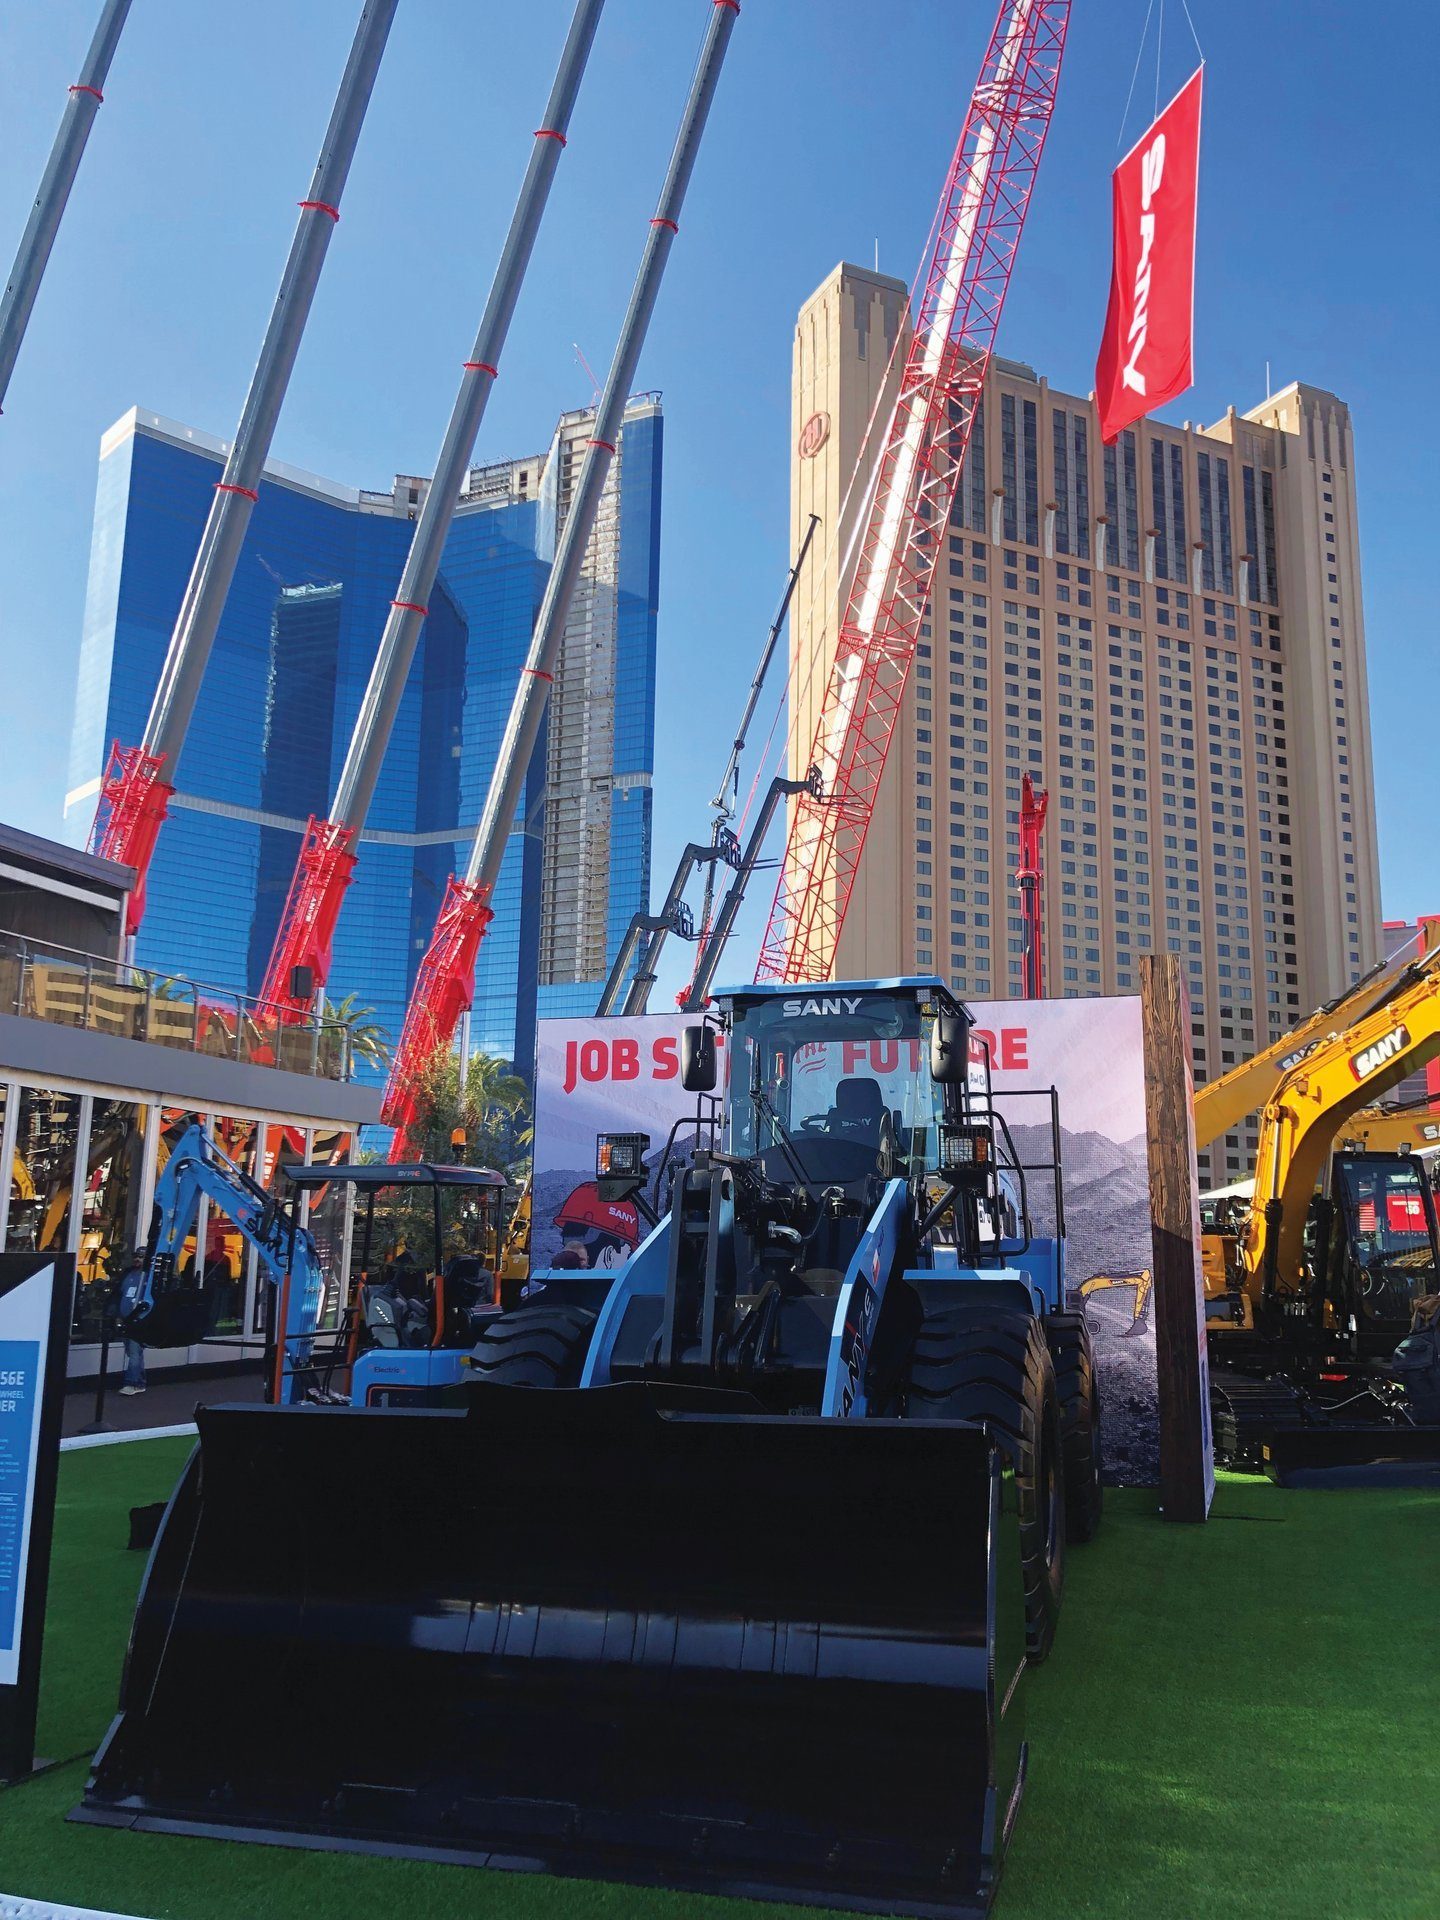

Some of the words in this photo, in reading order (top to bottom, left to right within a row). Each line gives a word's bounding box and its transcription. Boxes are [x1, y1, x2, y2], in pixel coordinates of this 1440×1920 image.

[783, 998, 863, 1018] SANY
[563, 1039, 640, 1095] JOB
[842, 1027, 1029, 1075] FUTRE
[1356, 1025, 1404, 1079] SANY
[608, 1206, 636, 1224] SANY
[0, 1400, 16, 1412] ER
